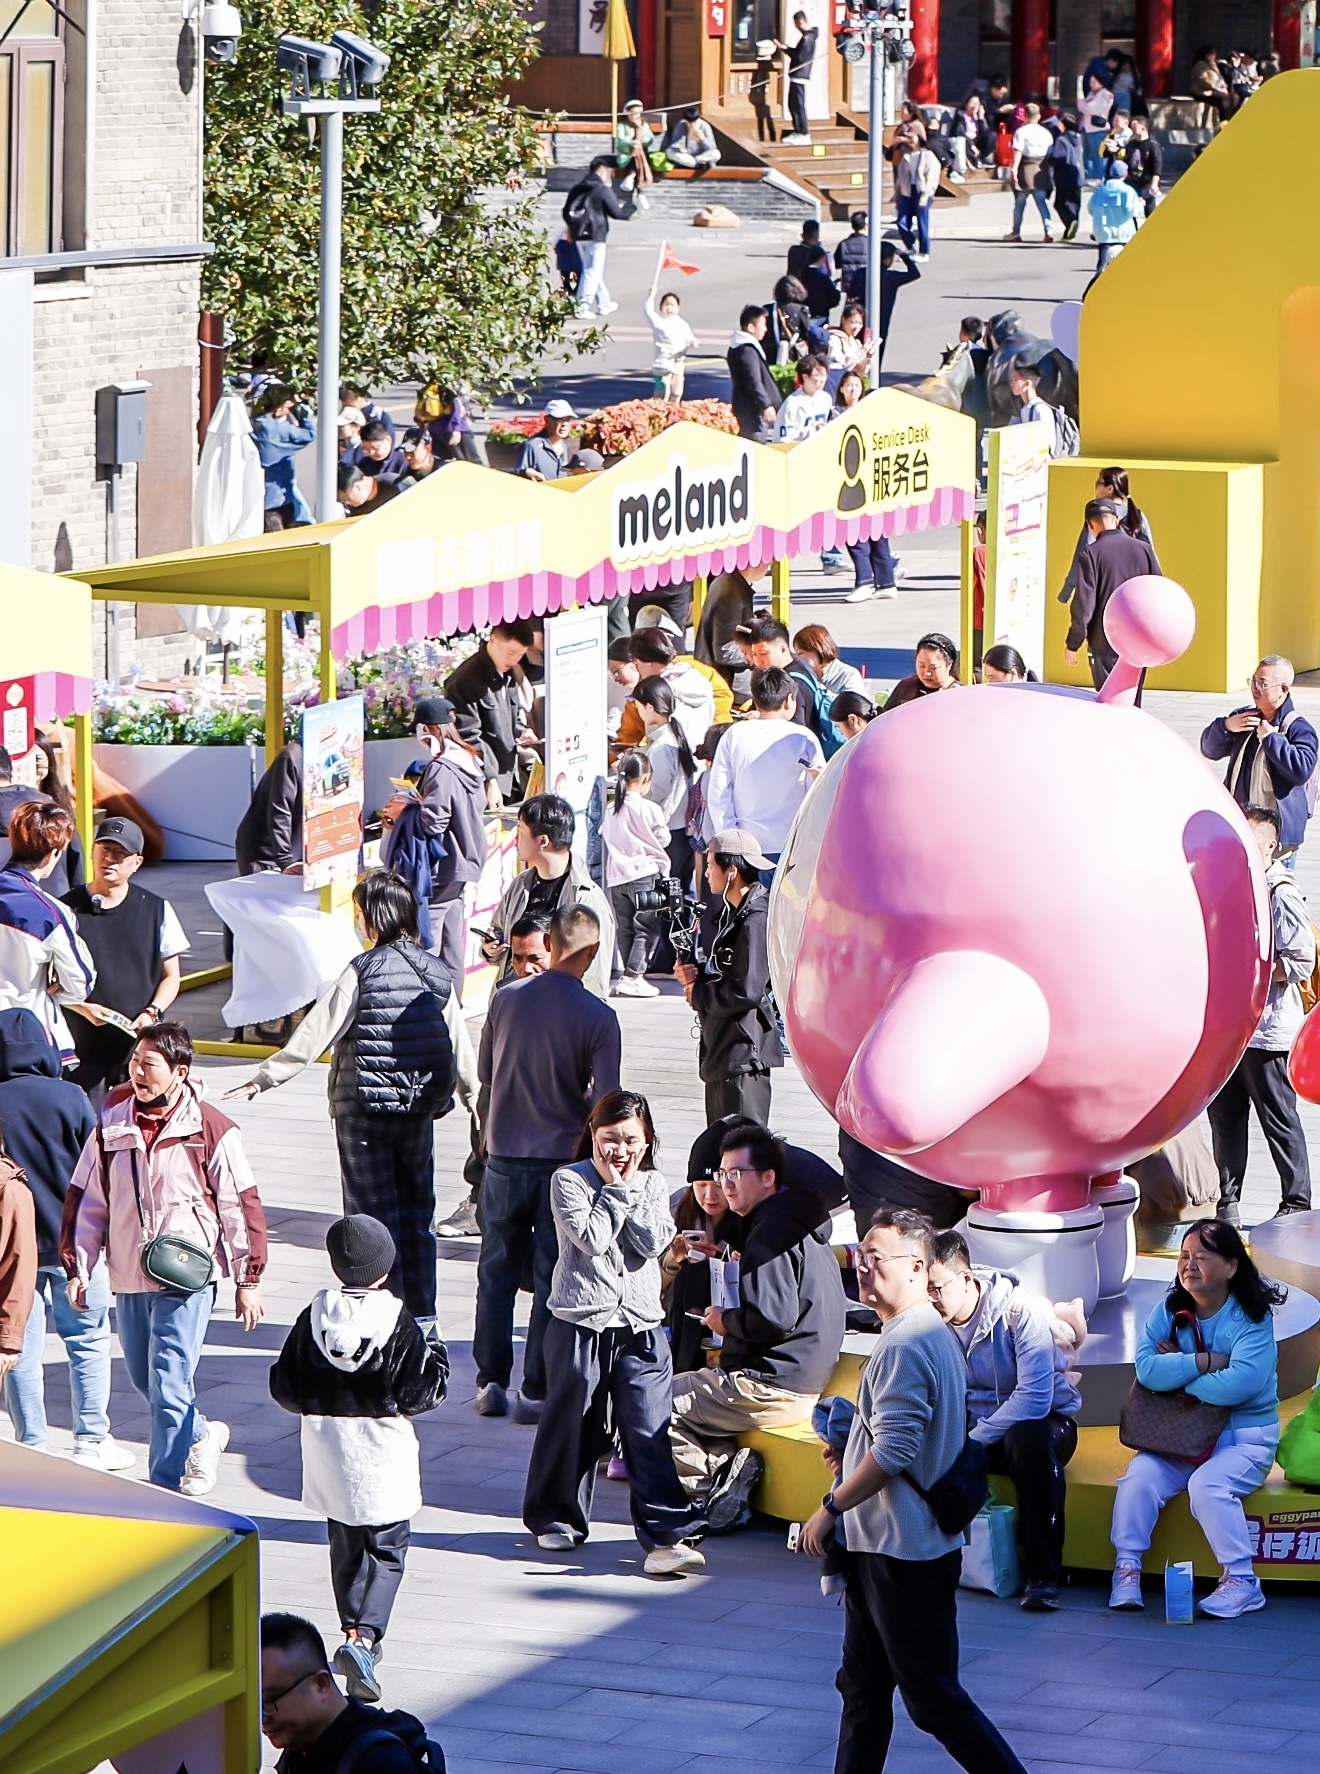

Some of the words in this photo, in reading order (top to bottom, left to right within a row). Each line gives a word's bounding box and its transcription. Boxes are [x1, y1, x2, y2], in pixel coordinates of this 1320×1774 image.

[872, 428, 906, 451] Service
[907, 423, 930, 445] Desk
[618, 452, 748, 548] meland
[872, 449, 929, 502] 服务台
